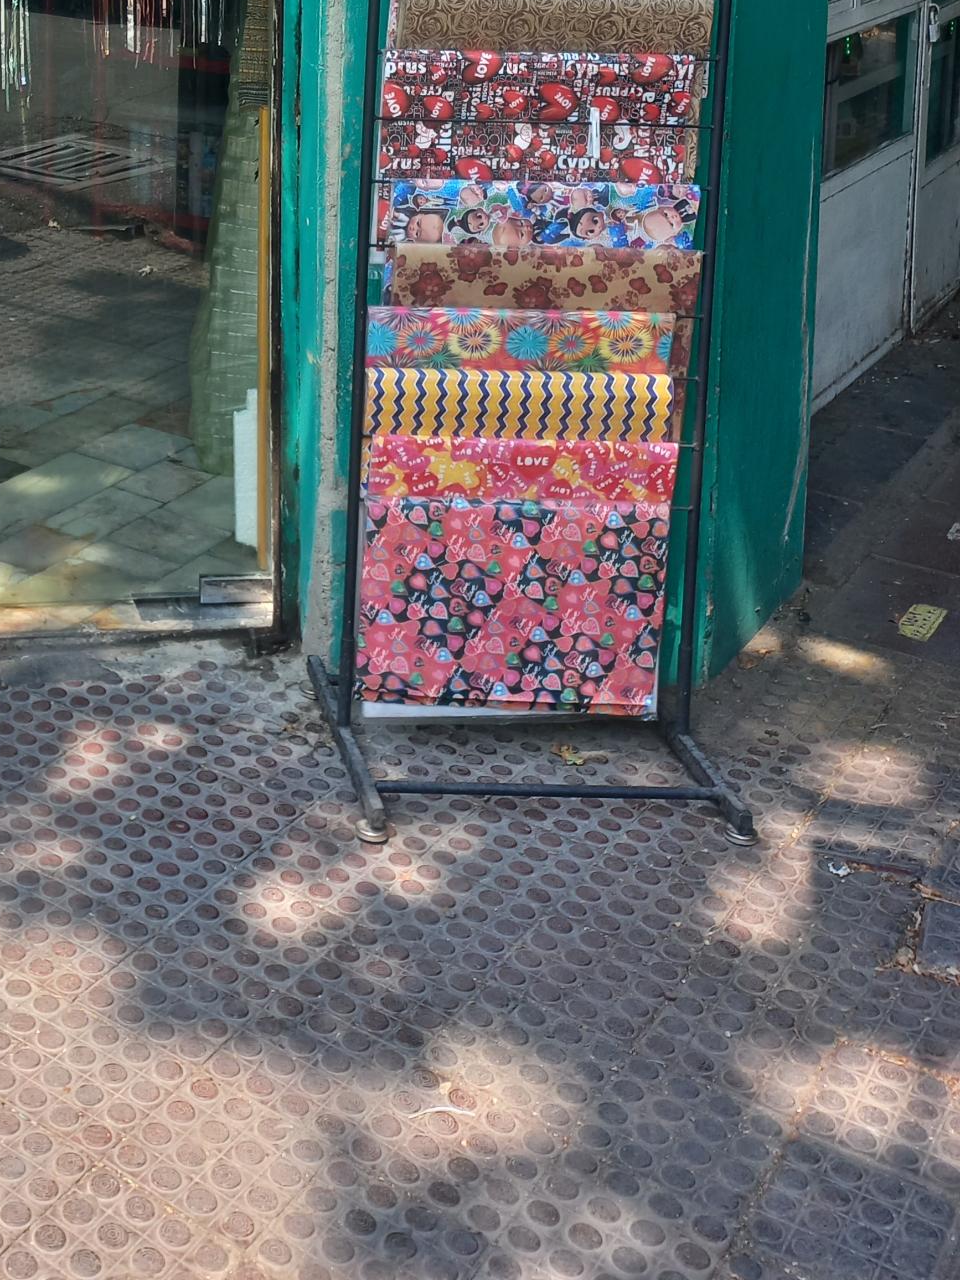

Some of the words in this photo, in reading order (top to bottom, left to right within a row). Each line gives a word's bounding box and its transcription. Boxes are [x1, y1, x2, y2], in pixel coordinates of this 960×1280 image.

[474, 52, 493, 79] LOVE
[641, 56, 657, 77] LOVE
[384, 91, 403, 118] LOVE
[509, 96, 525, 109] LOVE
[554, 92, 572, 110] LOVE
[675, 98, 690, 114] LOVE
[430, 101, 444, 118] LOVE
[600, 104, 614, 121] LOVE
[616, 443, 633, 458] LOVE
[649, 443, 672, 459] LOVE
[516, 456, 550, 467] LOVE
[412, 480, 435, 493] LOVE
[550, 485, 571, 496] LOVE
